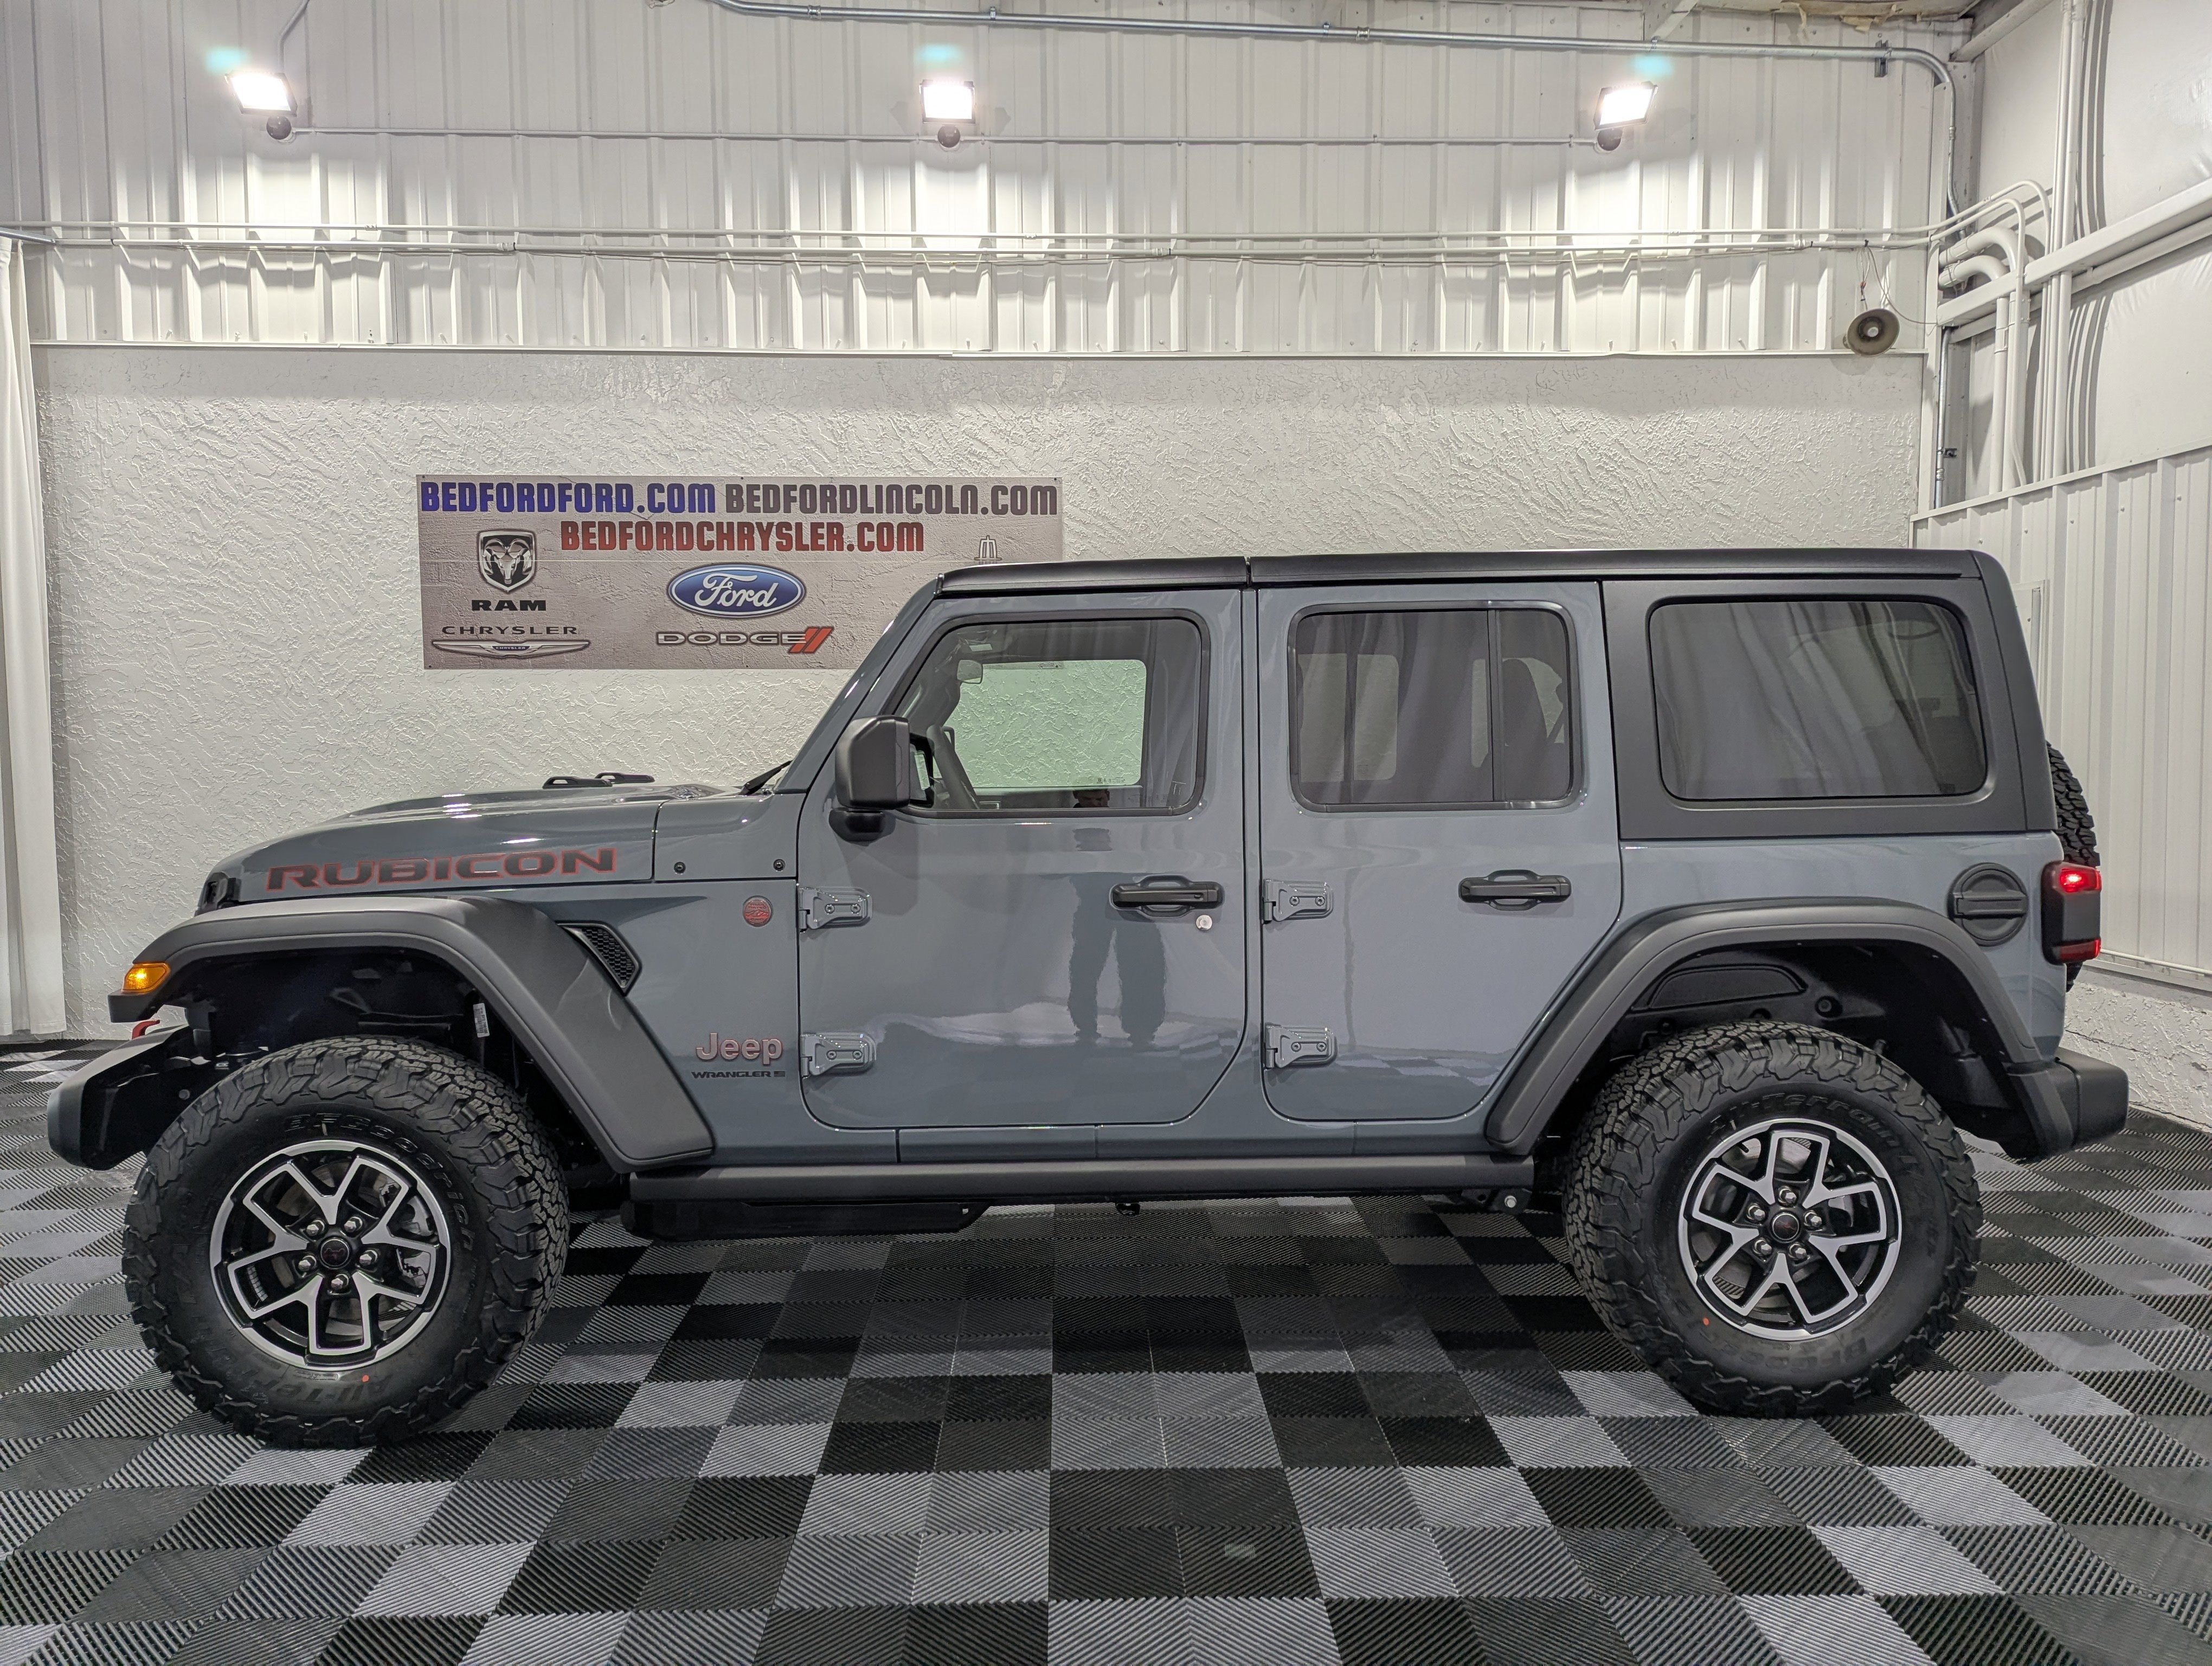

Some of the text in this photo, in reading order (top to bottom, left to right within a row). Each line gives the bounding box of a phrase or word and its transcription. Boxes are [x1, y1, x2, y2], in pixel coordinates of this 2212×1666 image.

[421, 482, 1057, 515] BEDFORDFORD.COM BEDFORDLINCOLN.COM
[561, 521, 924, 552] BEDFORDCHRYSLER.COM
[471, 599, 546, 611] RAM
[695, 573, 779, 607] Ford
[442, 626, 578, 635] CHRYSLER
[657, 632, 807, 645] DODGE
[266, 848, 616, 892] RUBICON
[695, 1032, 783, 1066] Jeep
[691, 1071, 772, 1079] WRANGLER
